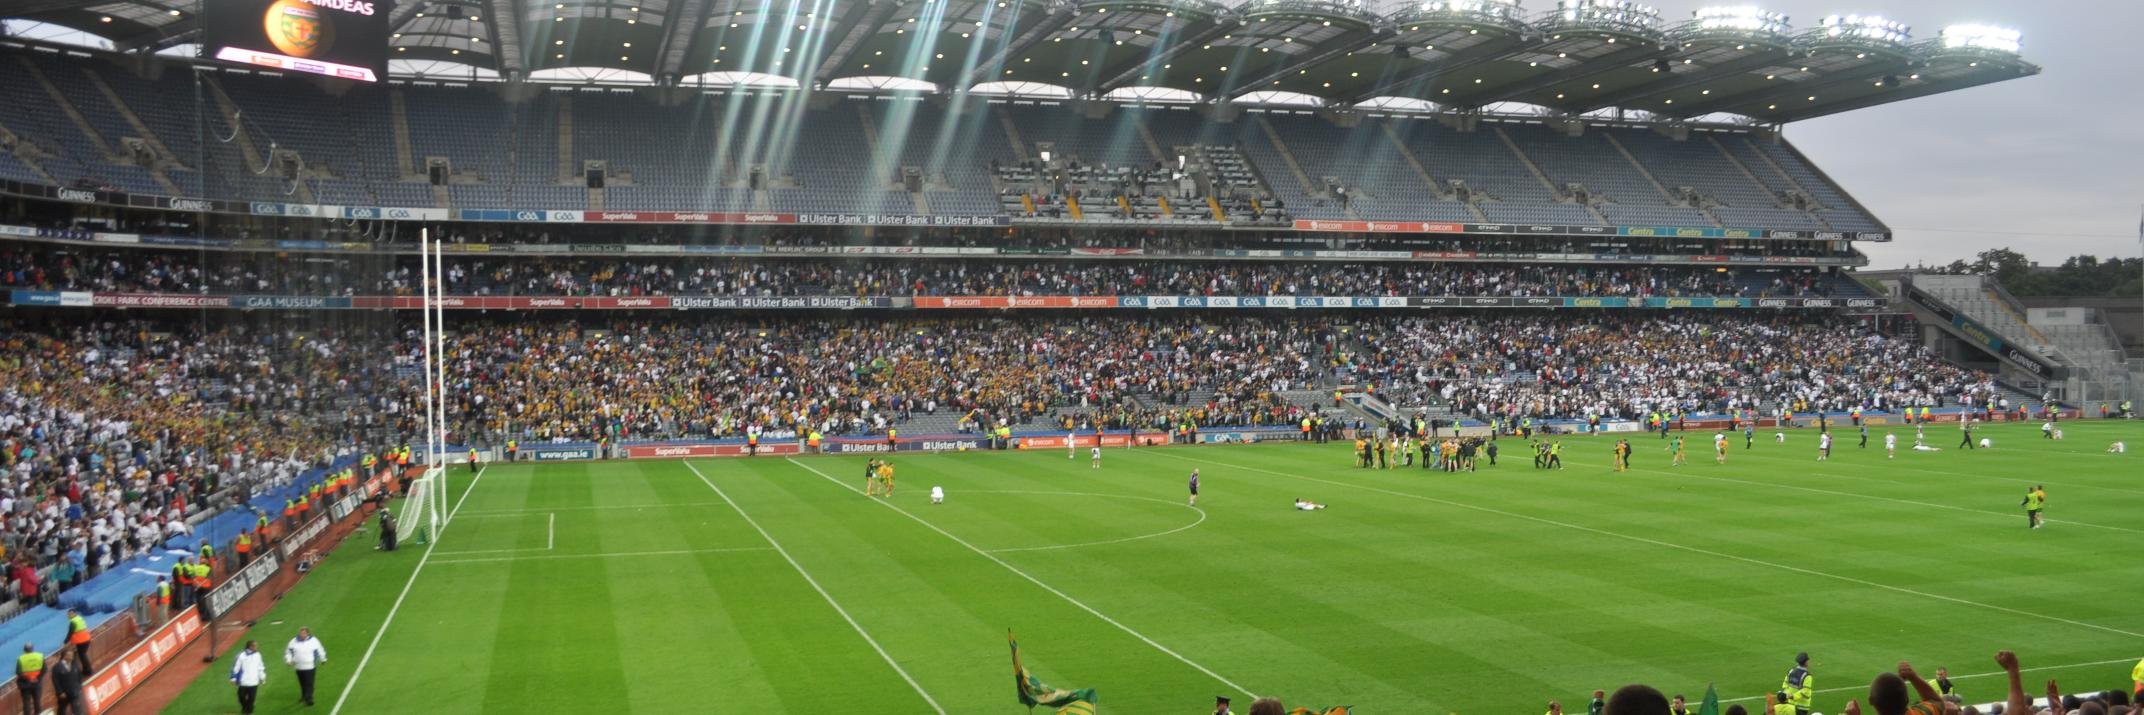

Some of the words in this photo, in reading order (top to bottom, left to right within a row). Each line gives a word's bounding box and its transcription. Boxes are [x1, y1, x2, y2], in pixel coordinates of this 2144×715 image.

[809, 214, 836, 224] Ulster
[838, 214, 863, 224] Bank
[876, 215, 904, 225] Ulster
[905, 215, 929, 225] Bank
[944, 216, 968, 225] Ulster
[970, 216, 994, 226] Bank
[93, 295, 117, 304] CROKE
[118, 295, 140, 305] PARK
[142, 296, 196, 306] CONFERENCE
[198, 297, 229, 306] CENTRE
[248, 297, 272, 307] GAA
[276, 298, 323, 307] MUSEUM
[682, 298, 711, 307] Ulster
[752, 298, 780, 307] Ulster
[821, 297, 848, 307] Ulster
[540, 449, 588, 460] www.gaa.ie
